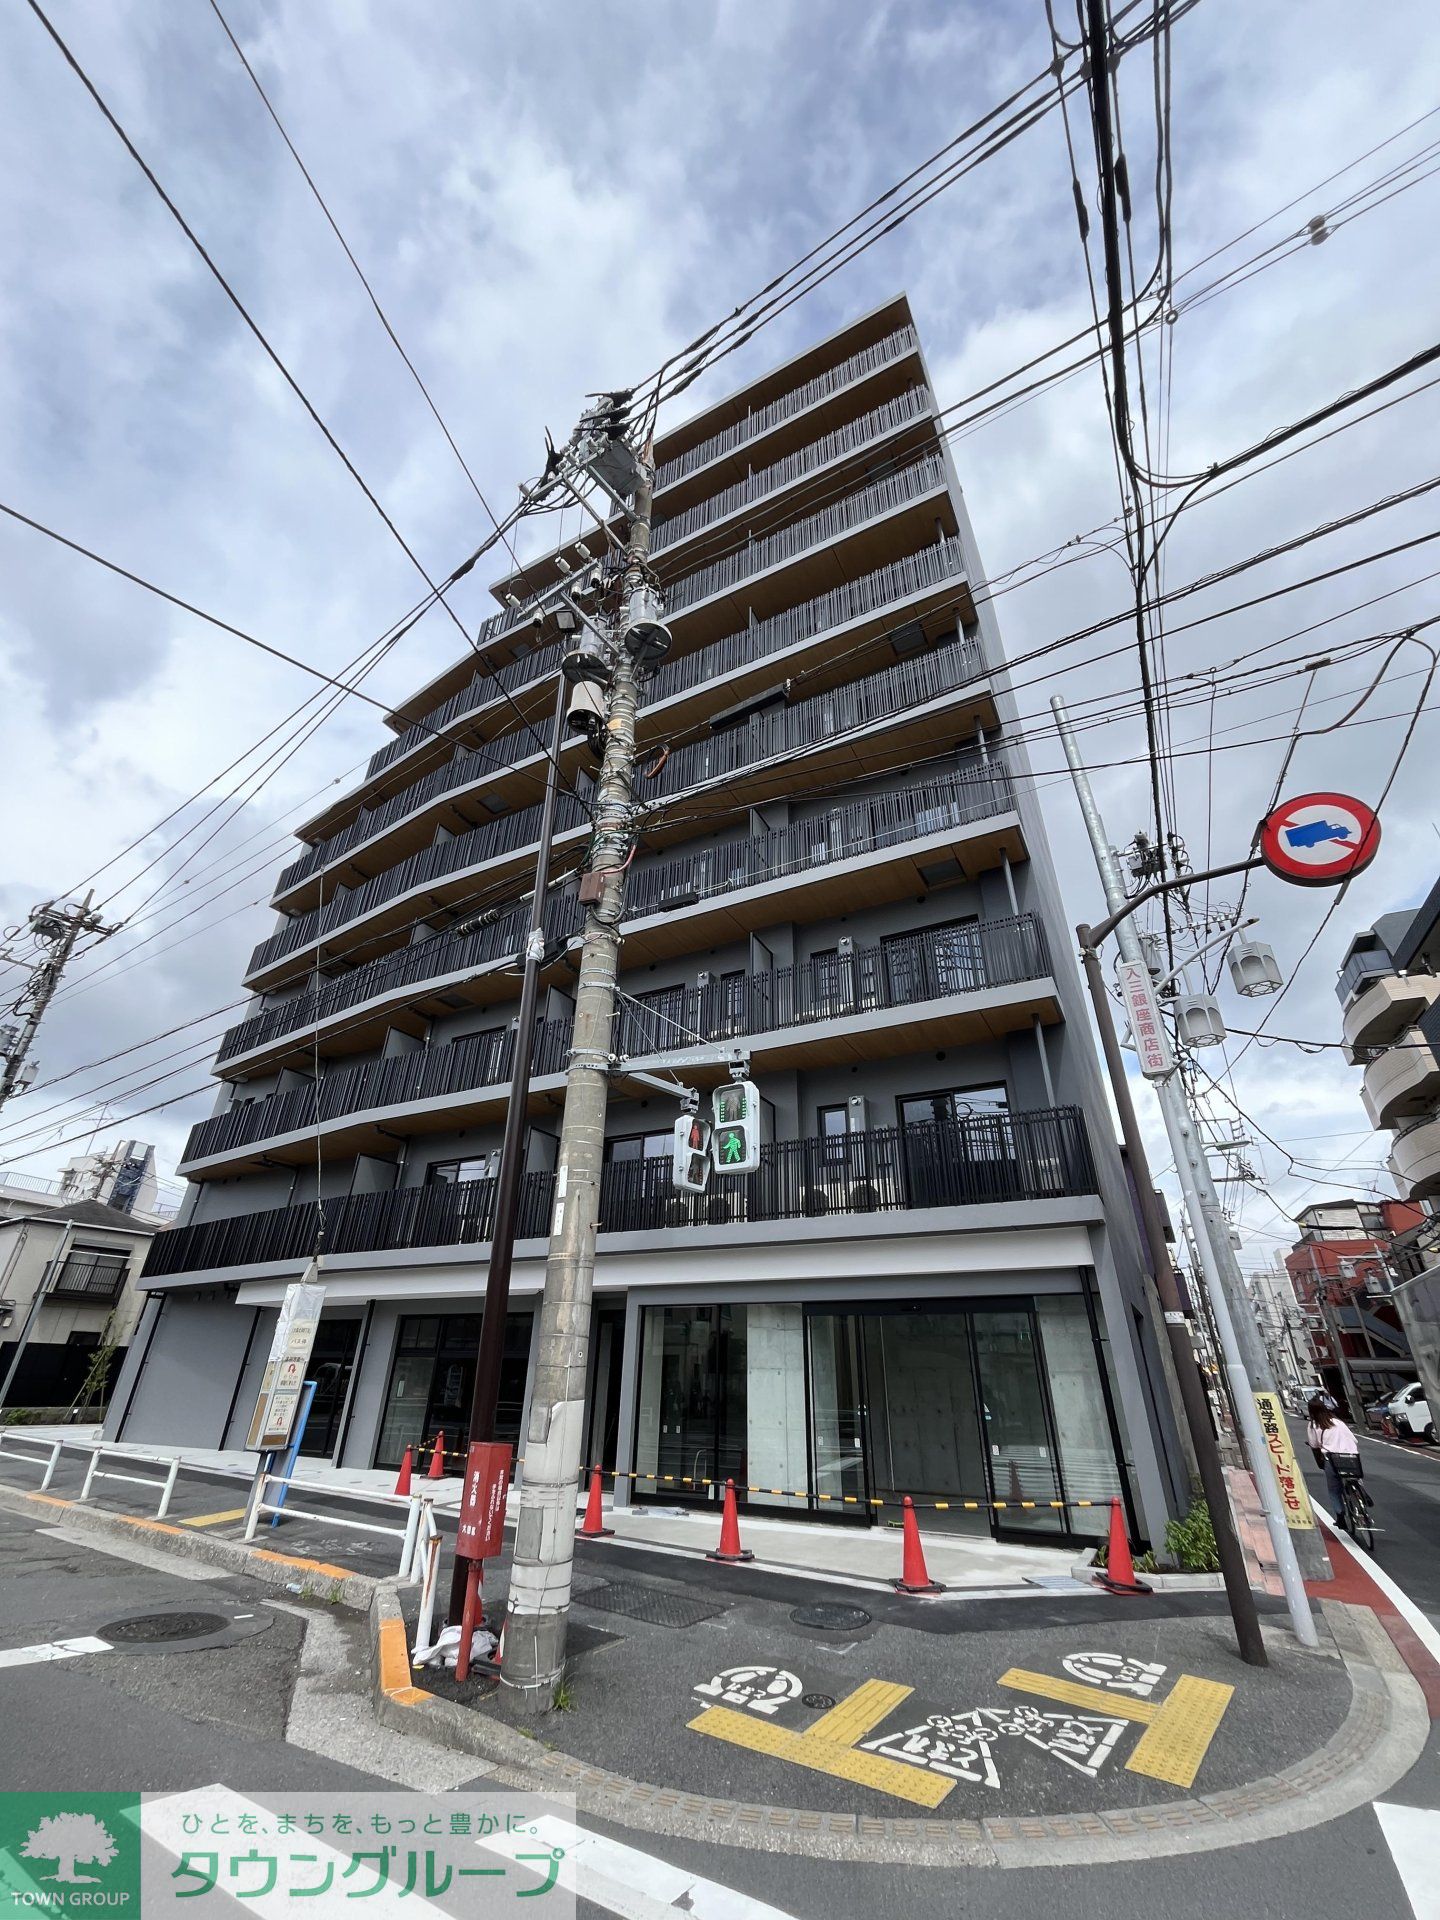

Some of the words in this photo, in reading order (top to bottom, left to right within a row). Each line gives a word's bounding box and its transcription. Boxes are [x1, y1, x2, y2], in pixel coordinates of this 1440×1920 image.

[1126, 968, 1163, 1068] 入三銀座商店街
